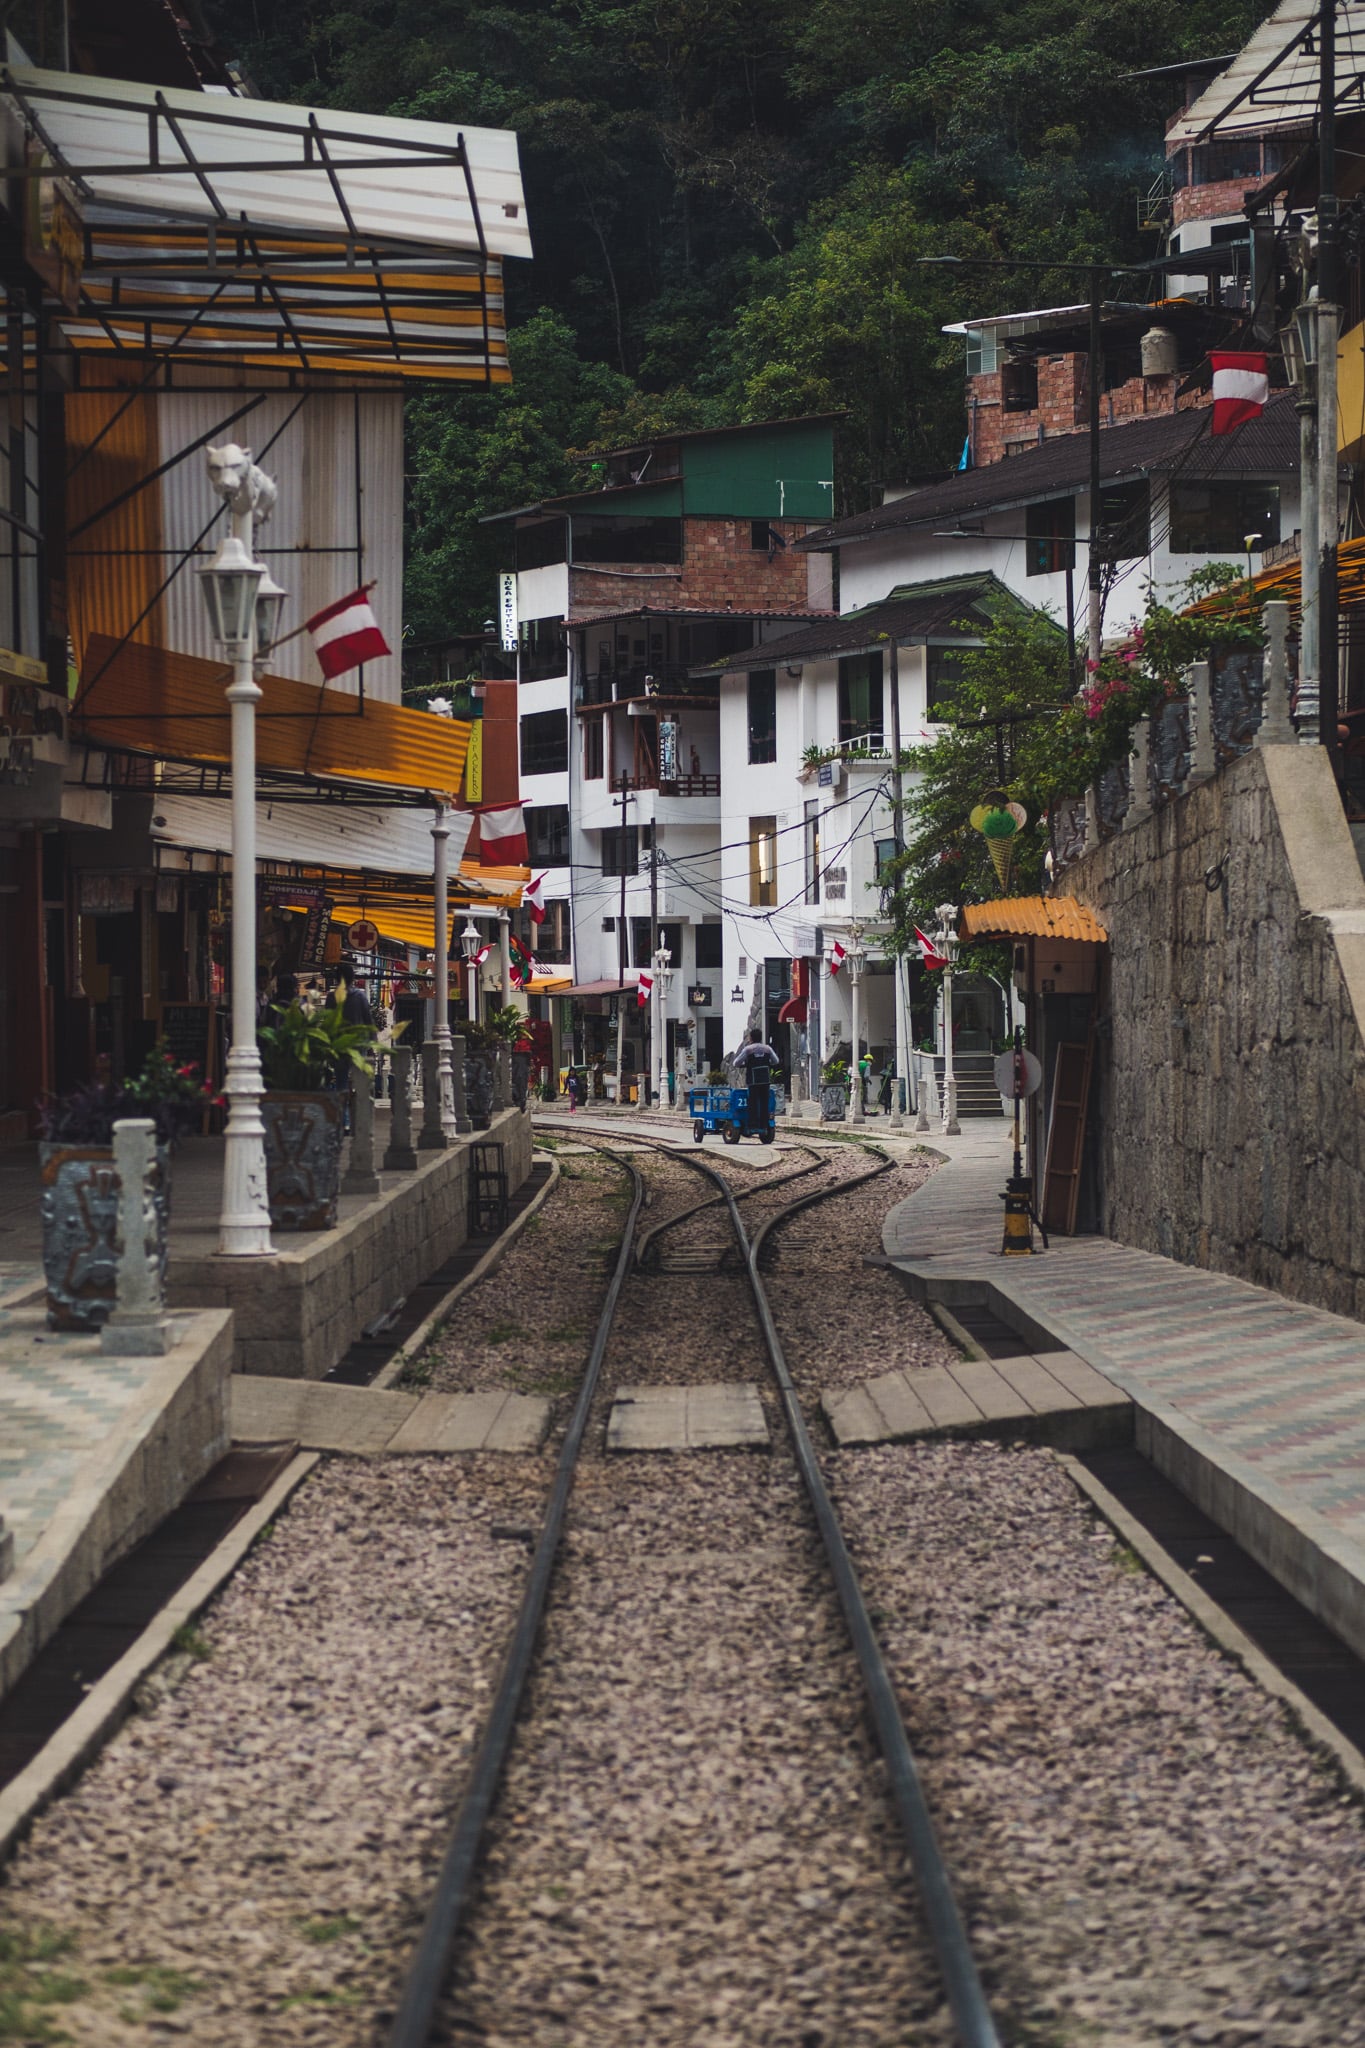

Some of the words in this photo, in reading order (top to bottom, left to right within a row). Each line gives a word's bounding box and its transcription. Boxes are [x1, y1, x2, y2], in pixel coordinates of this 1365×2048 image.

[504, 575, 513, 596] INCA
[268, 885, 320, 896] HOSPEDAJE
[314, 907, 332, 964] MASSAGE
[737, 1097, 748, 1107] 21
[705, 1119, 713, 1129] 21
